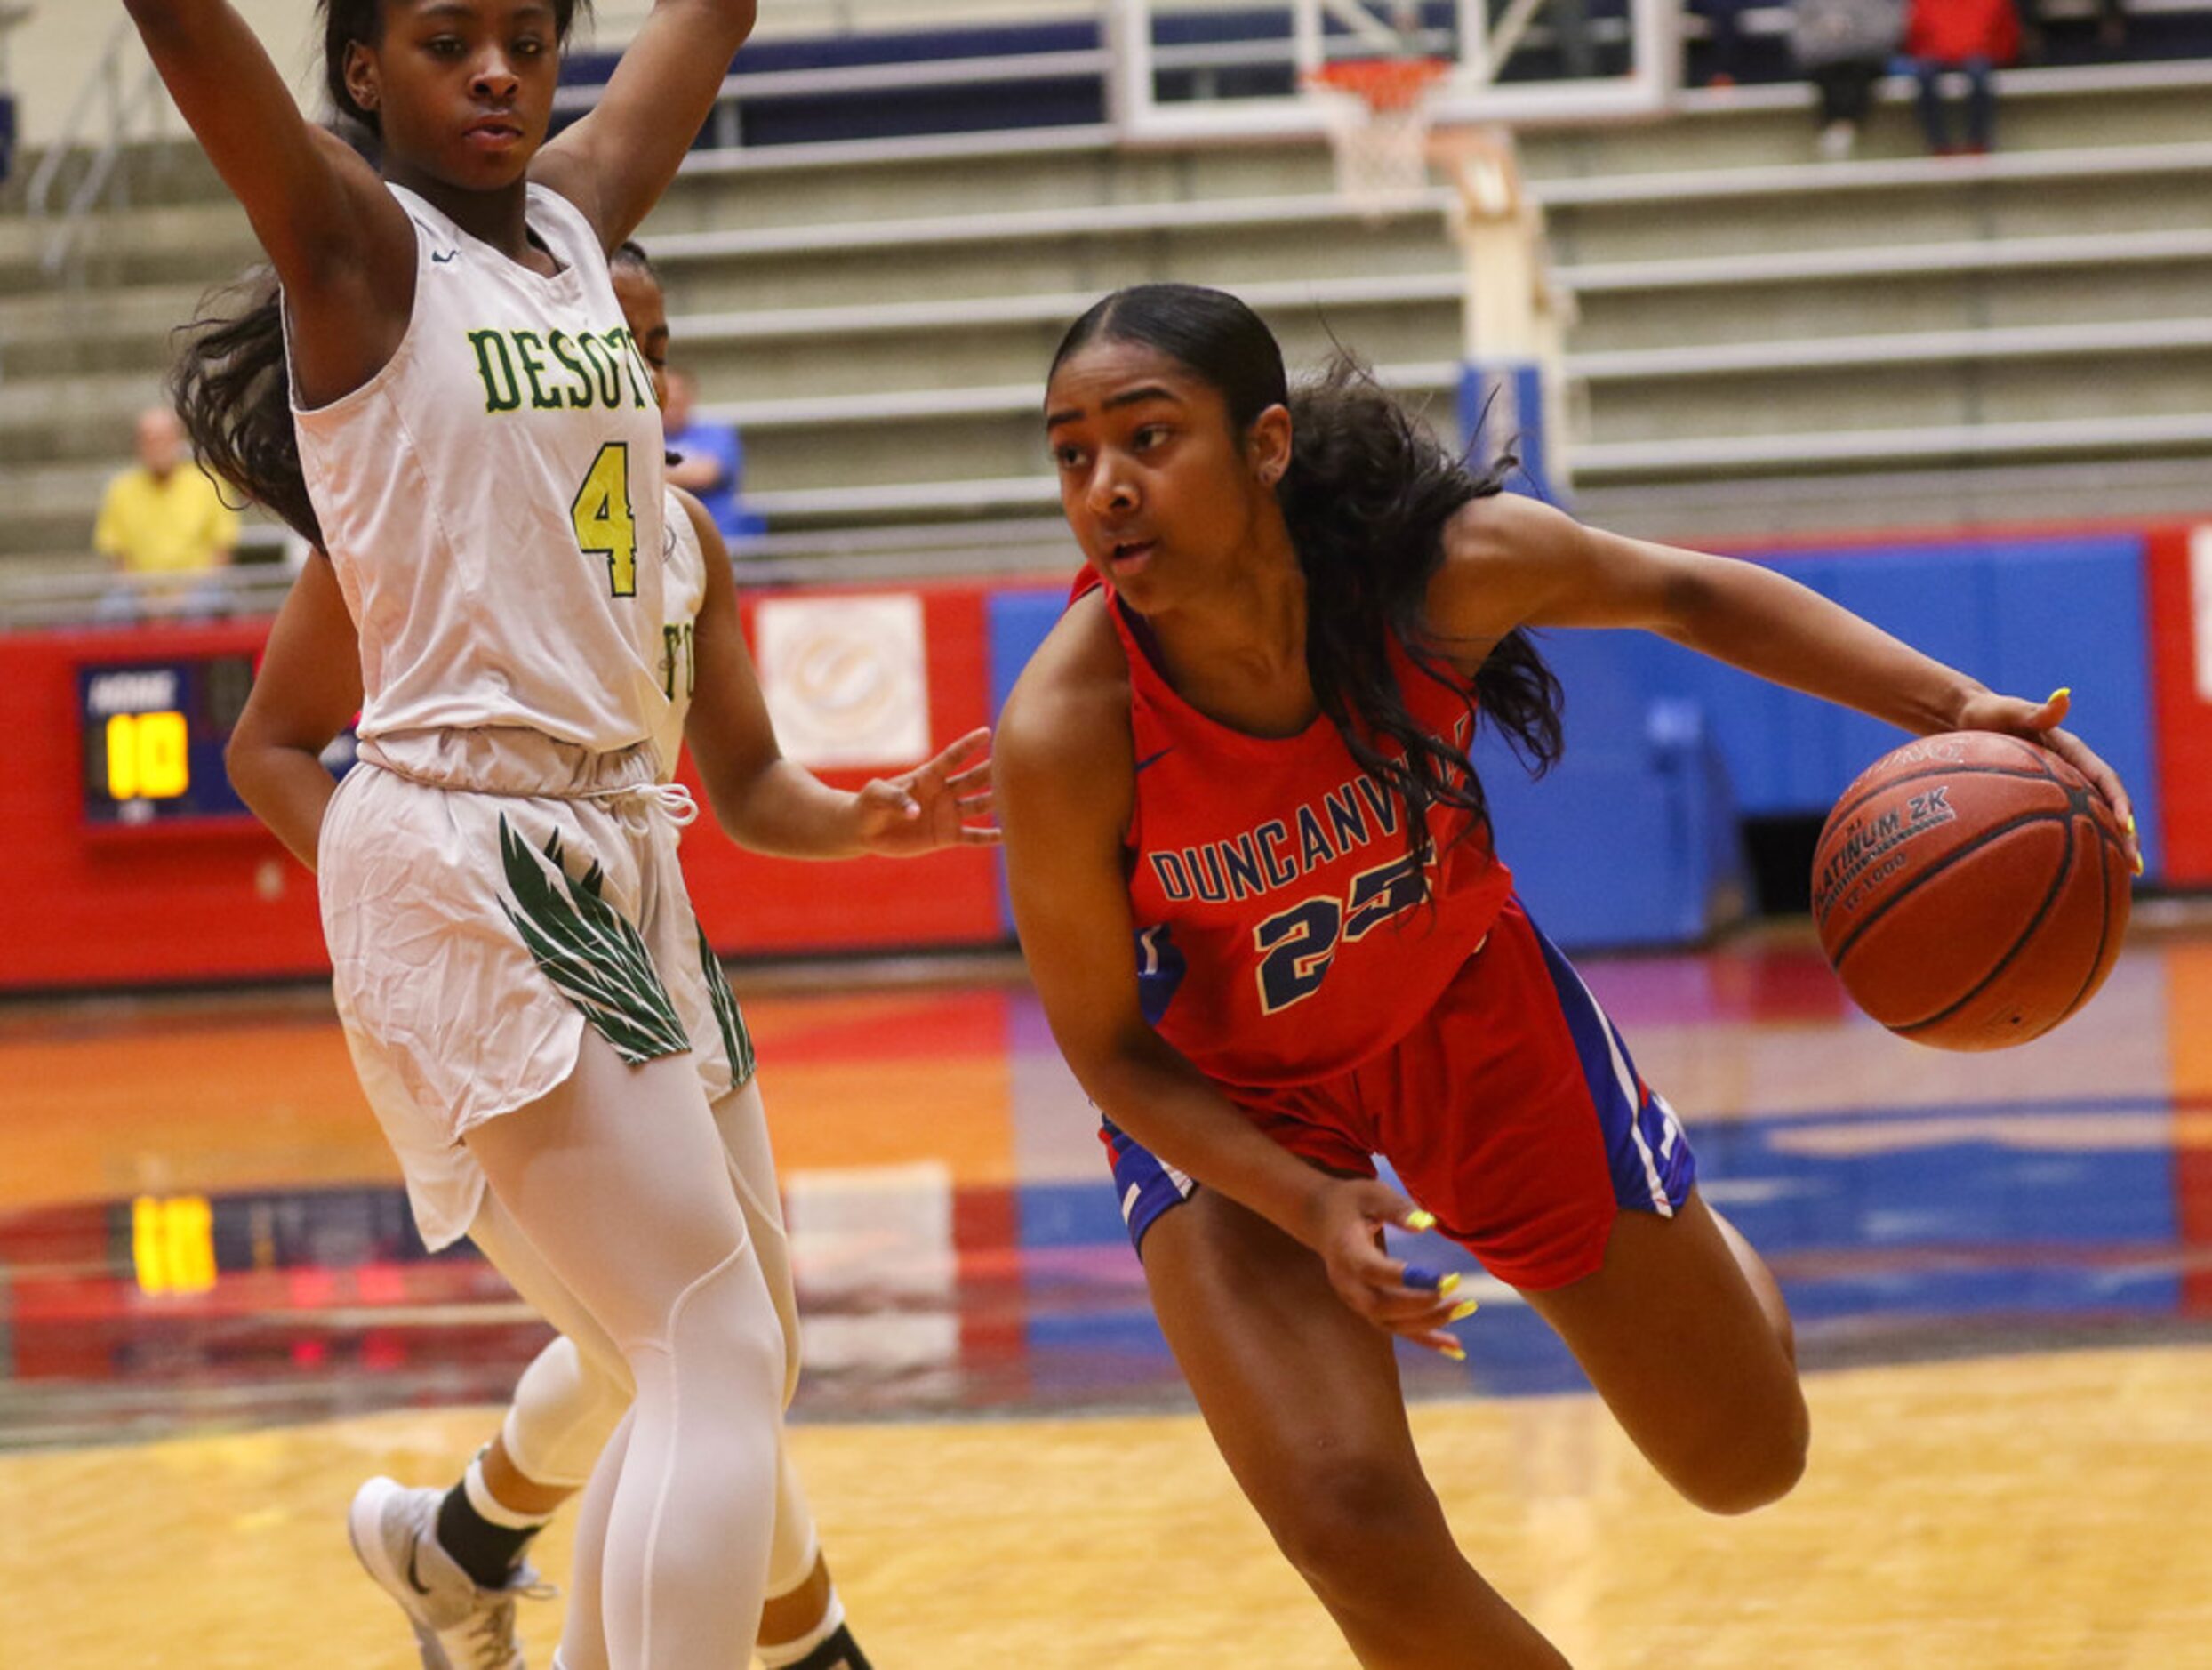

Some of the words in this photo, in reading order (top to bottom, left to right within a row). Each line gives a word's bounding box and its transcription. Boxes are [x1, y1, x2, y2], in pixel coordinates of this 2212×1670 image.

[570, 441, 637, 598] 4
[1148, 709, 1470, 903] DUNCANV
[1253, 836, 1437, 1016] 25
